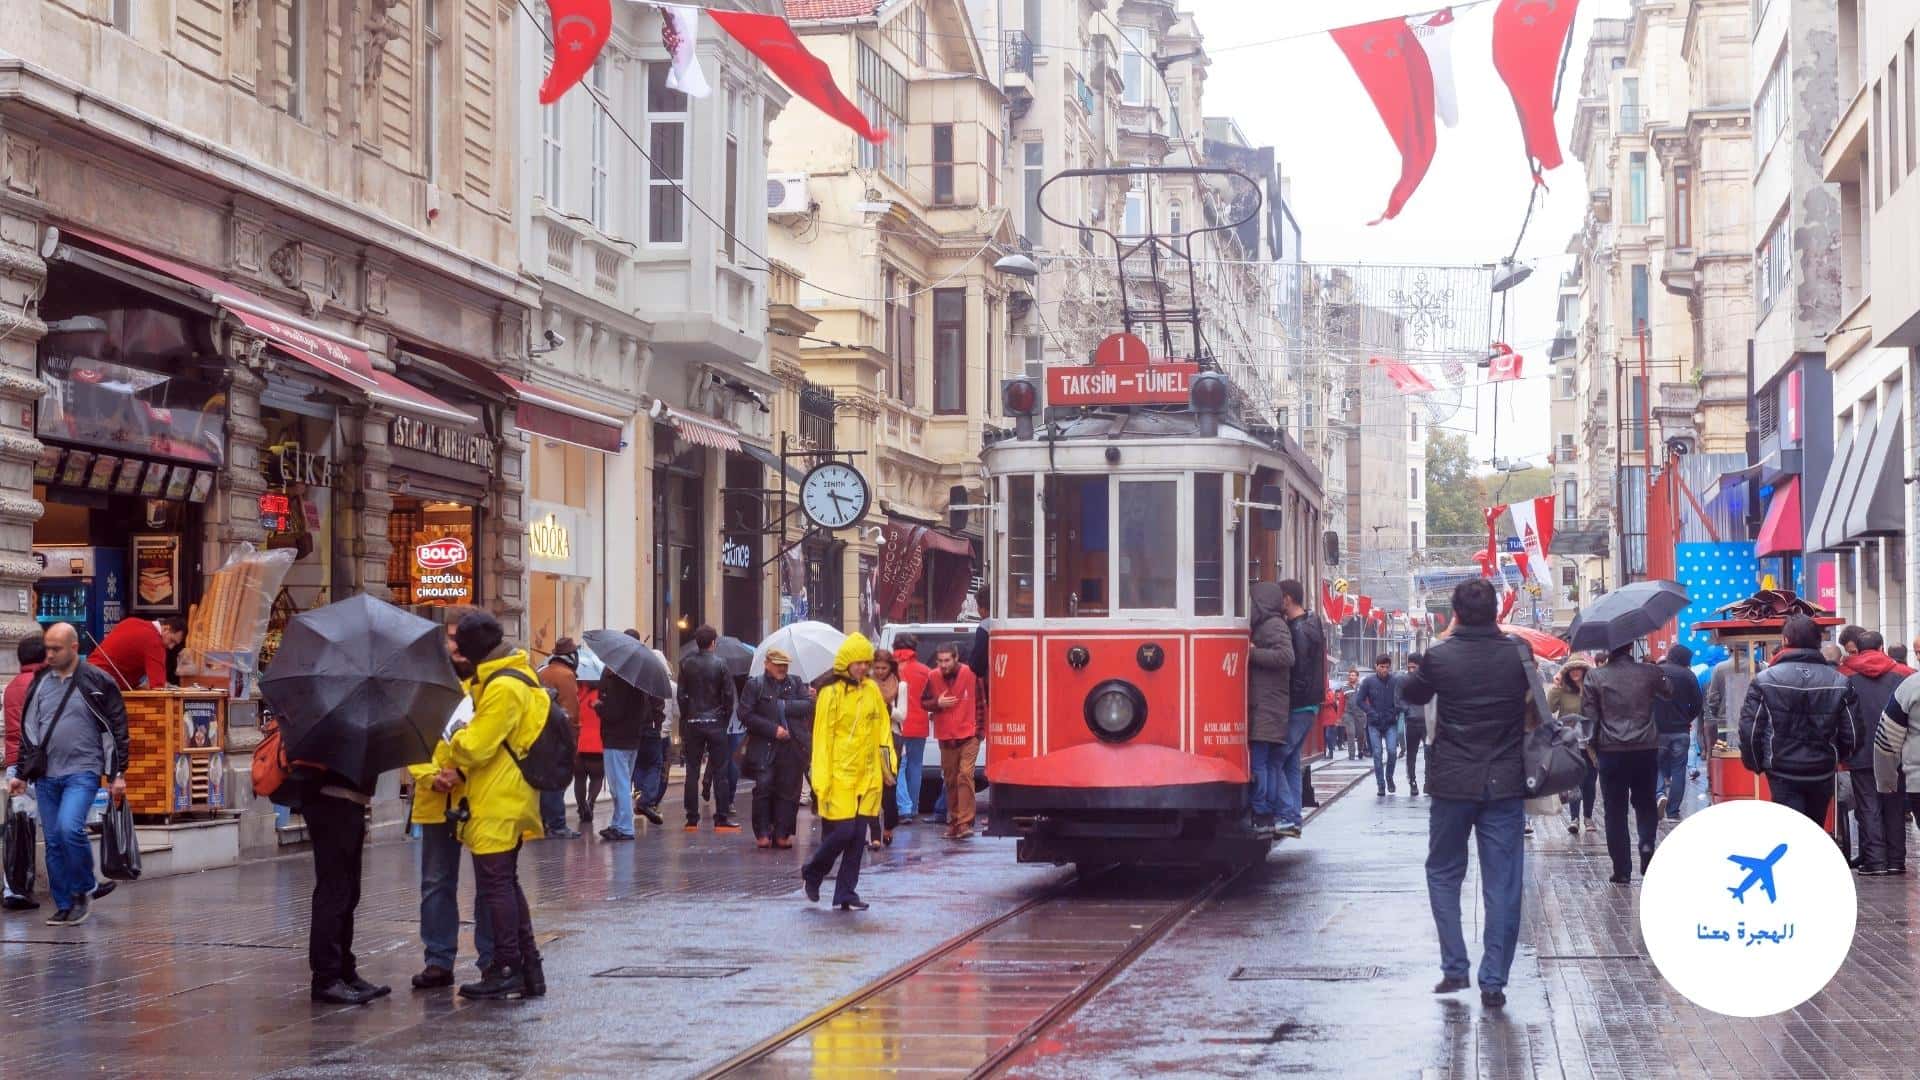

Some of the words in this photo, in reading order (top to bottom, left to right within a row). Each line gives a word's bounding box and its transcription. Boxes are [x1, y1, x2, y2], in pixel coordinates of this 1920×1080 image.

[1118, 337, 1125, 362] 1
[1060, 371, 1117, 396] TAKSİM
[1135, 370, 1189, 393] TÜNEL
[823, 481, 846, 489] ZENITH
[421, 574, 463, 584] BEYOĞLU
[416, 587, 467, 598] ÇİKOLATASI
[994, 653, 1008, 678] 47
[1222, 652, 1239, 677] 47
